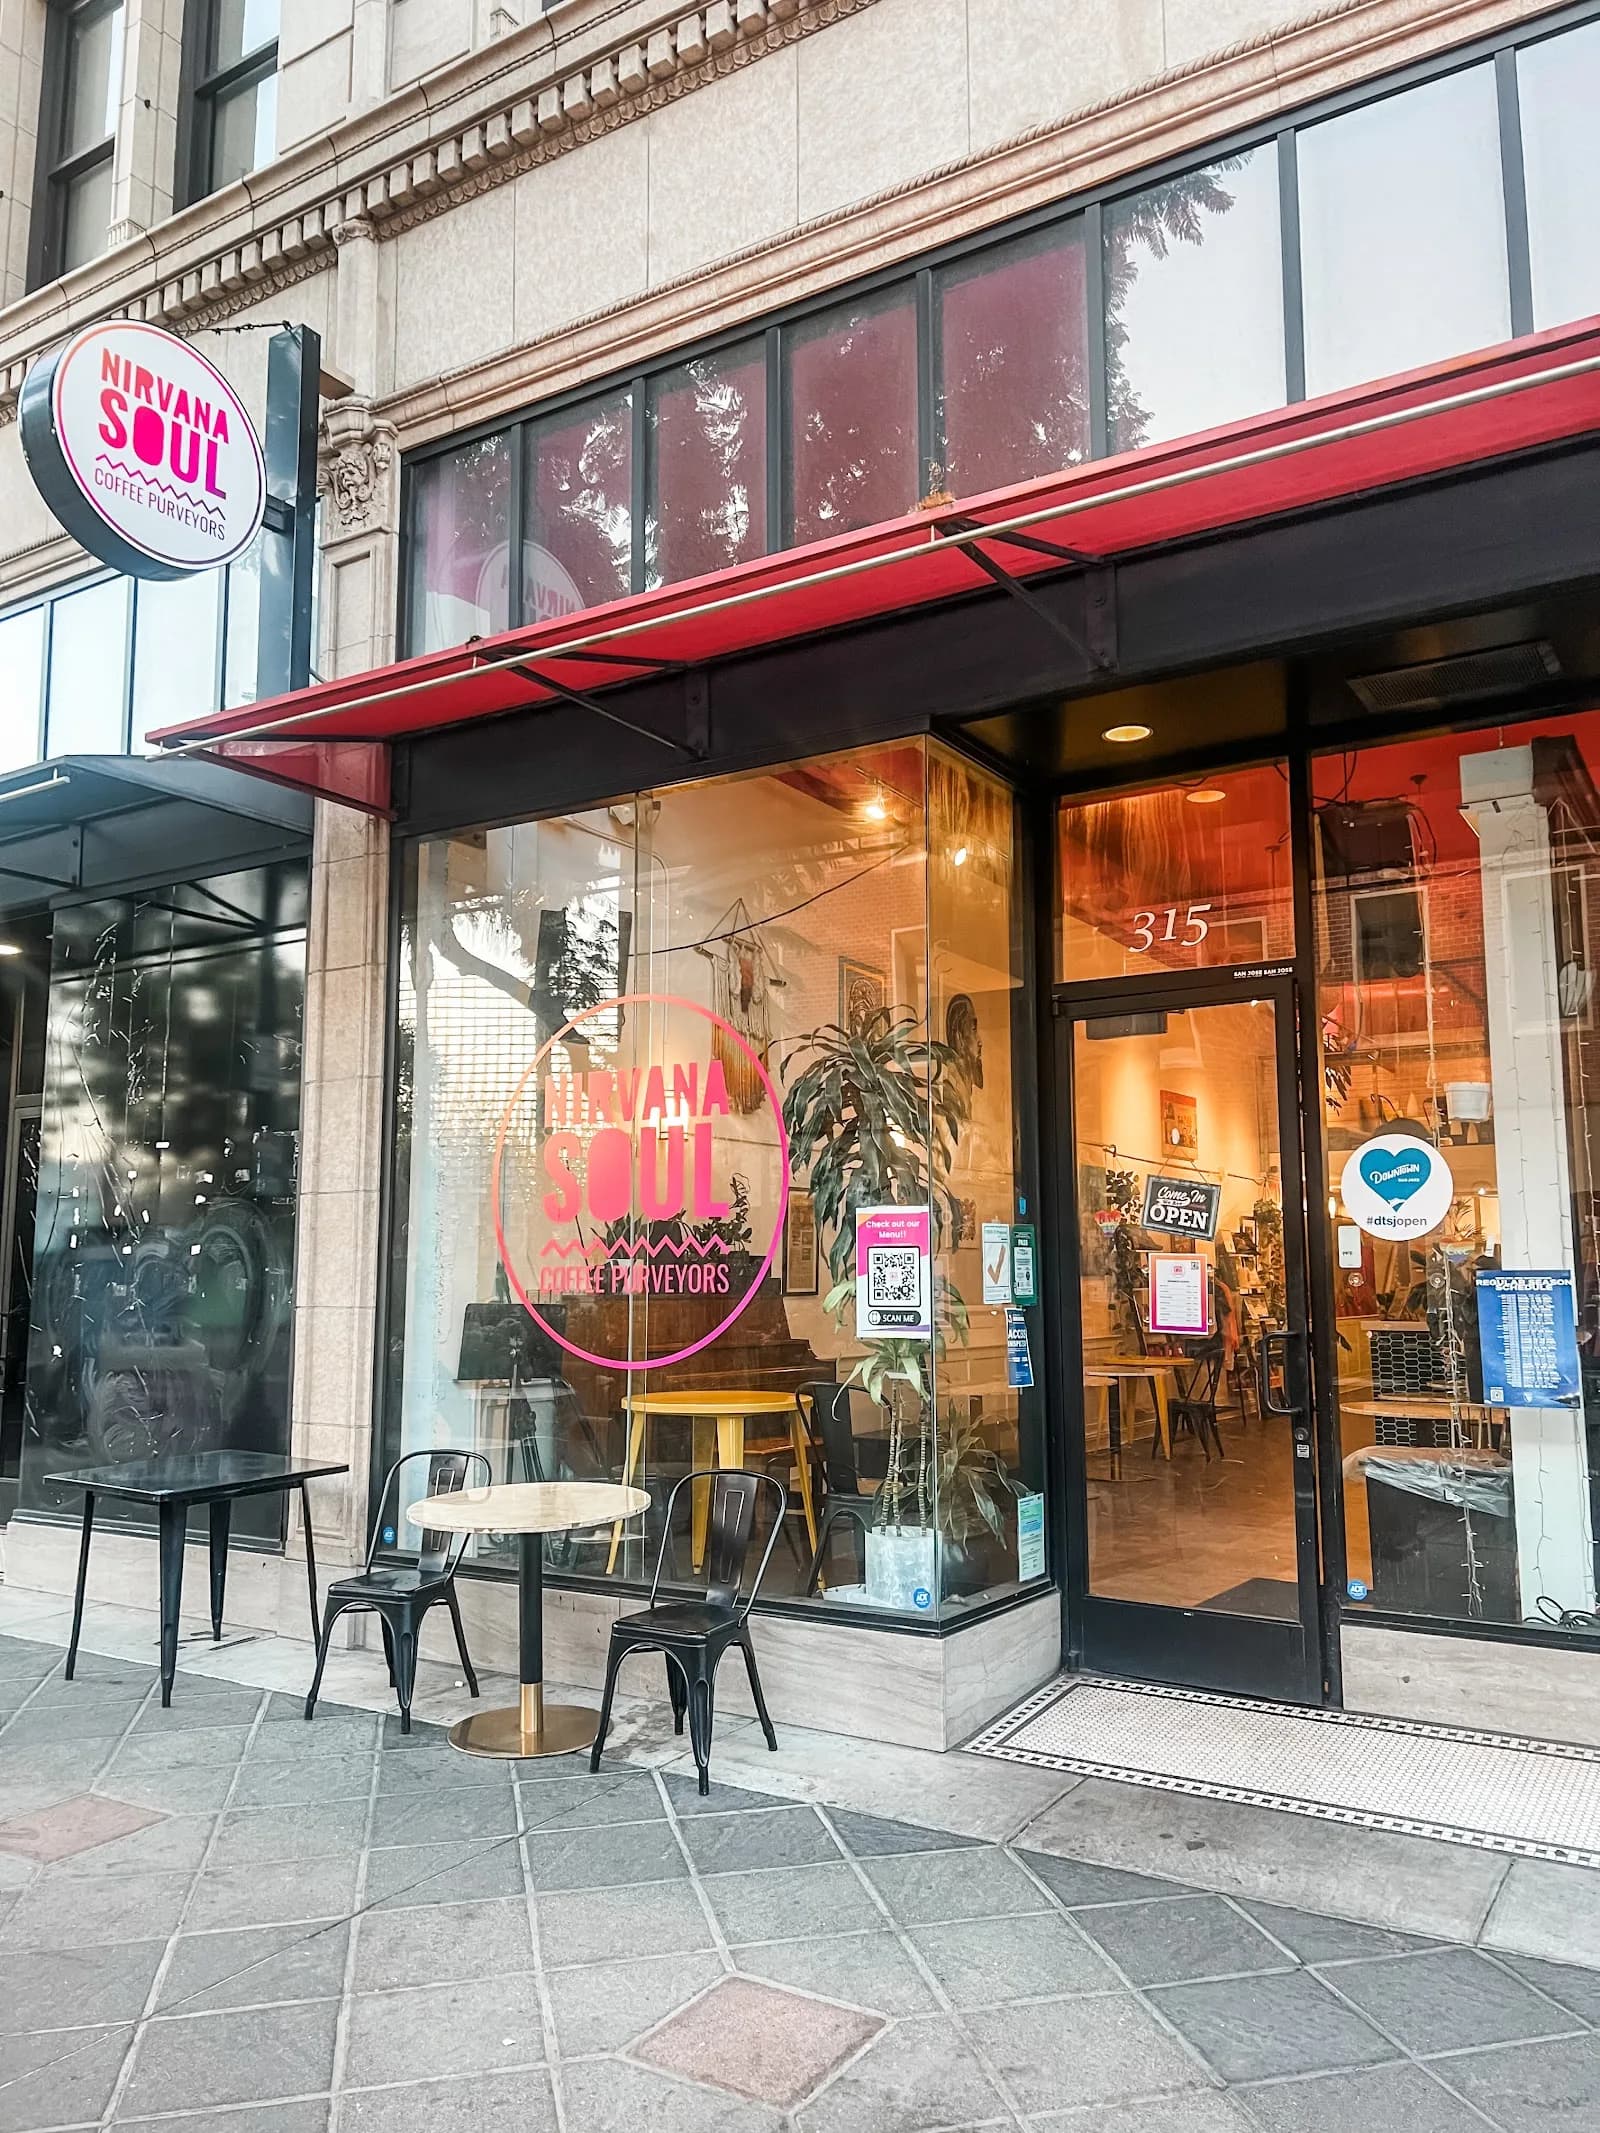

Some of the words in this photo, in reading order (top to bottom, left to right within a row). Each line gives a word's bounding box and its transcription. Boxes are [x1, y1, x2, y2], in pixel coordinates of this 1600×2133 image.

[102, 347, 229, 444] NIRVANA
[98, 388, 227, 500] SOUL
[94, 467, 143, 504] COFFEE
[149, 491, 226, 541] PURVEYORS
[1128, 903, 1212, 953] 315
[544, 1060, 729, 1128] NIRVANA
[543, 1122, 730, 1223] SOUL
[1157, 1186, 1188, 1200] Come
[1191, 1190, 1207, 1203] In
[865, 1220, 890, 1228] Check
[891, 1220, 904, 1228] out
[1149, 1204, 1209, 1230] OPEN
[1366, 1216, 1427, 1227] #dtsjopen
[878, 1230, 906, 1239] Menu!!
[539, 1265, 606, 1294] COFFEE
[611, 1264, 730, 1294] PURVEYORS
[882, 1314, 901, 1322] SCAN
